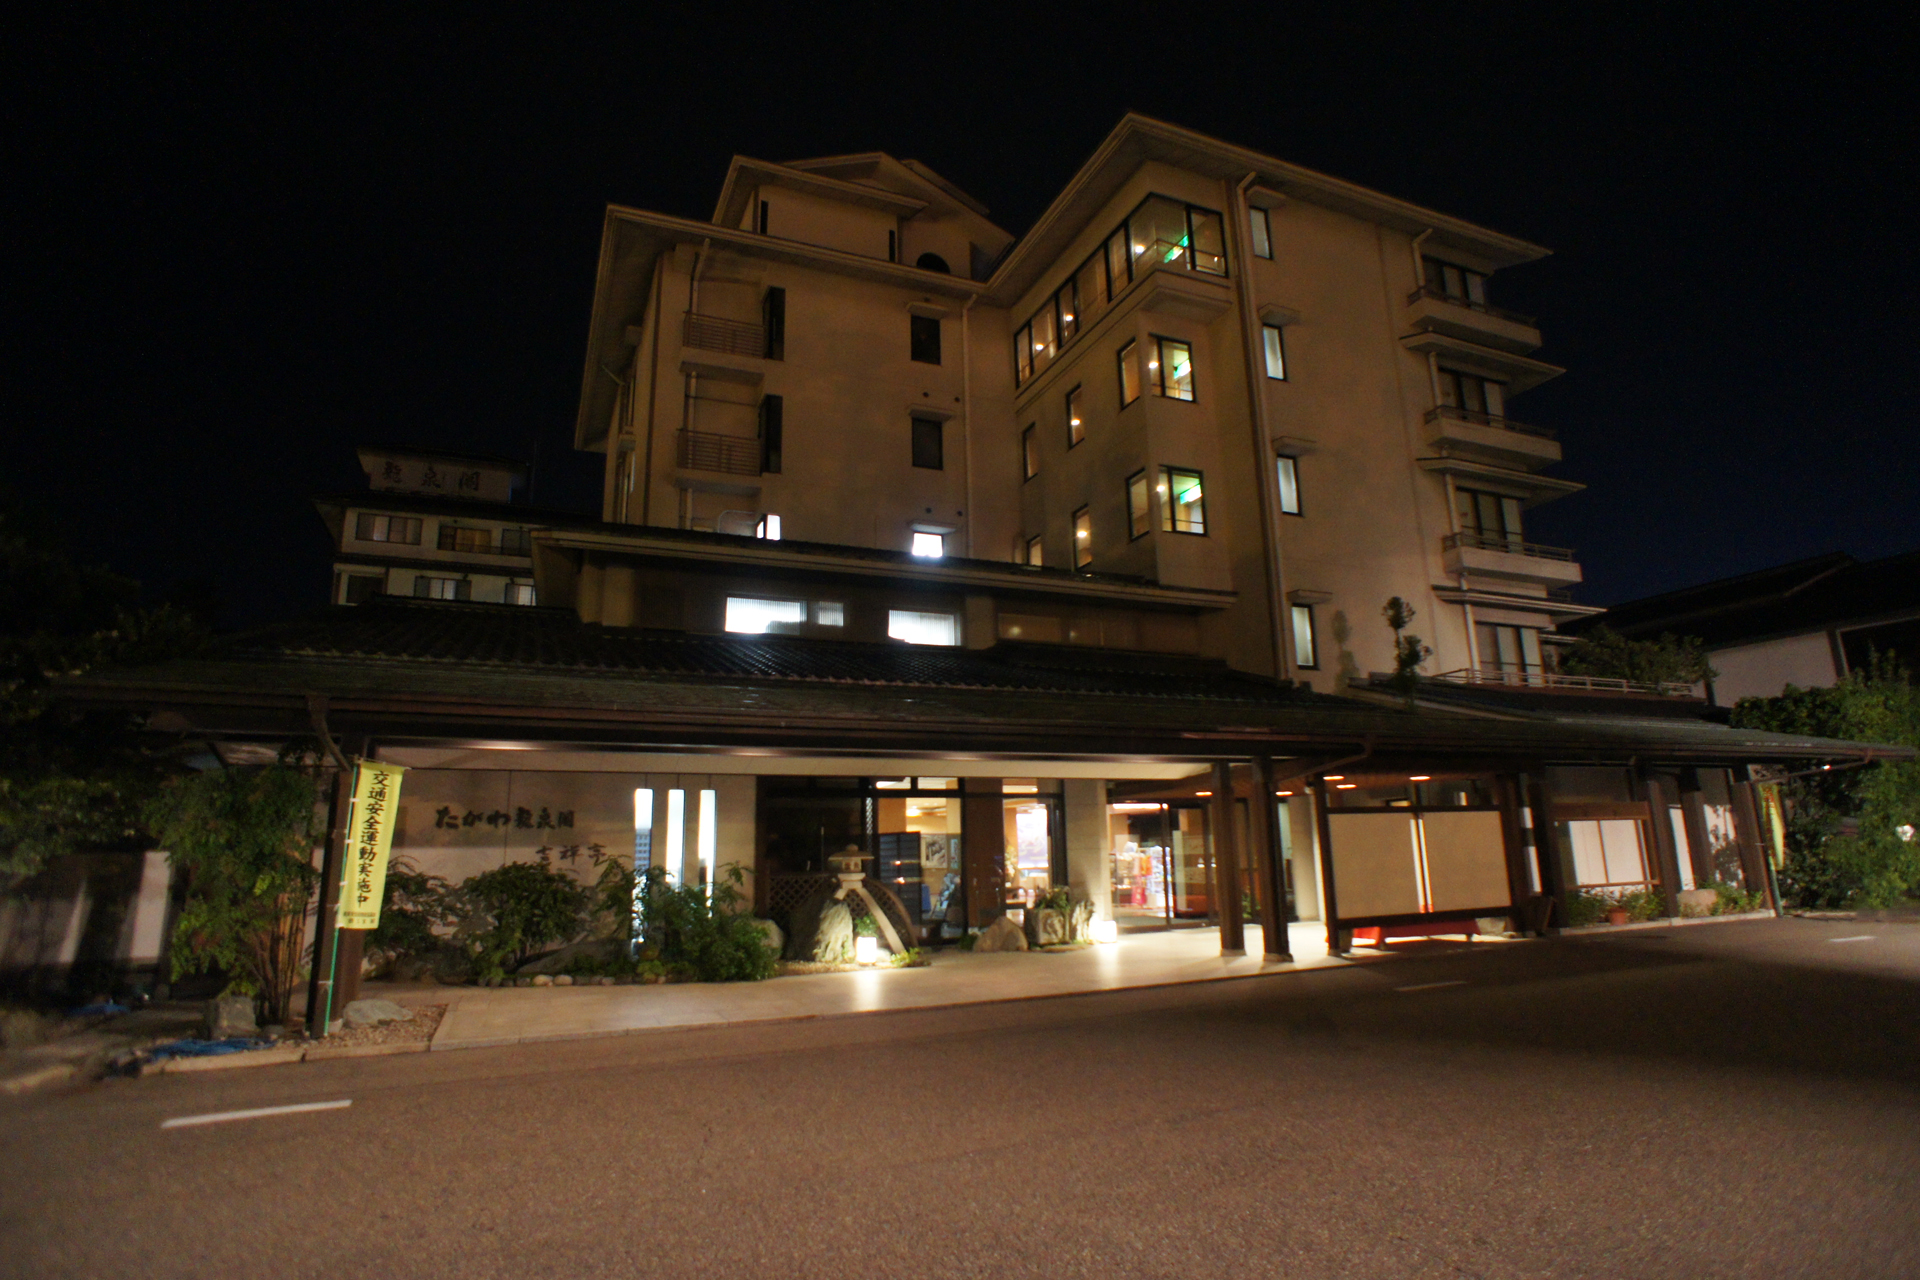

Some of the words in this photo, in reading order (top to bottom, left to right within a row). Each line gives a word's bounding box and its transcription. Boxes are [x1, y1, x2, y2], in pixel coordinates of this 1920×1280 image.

[357, 771, 391, 908] 交通安全運動実施中
